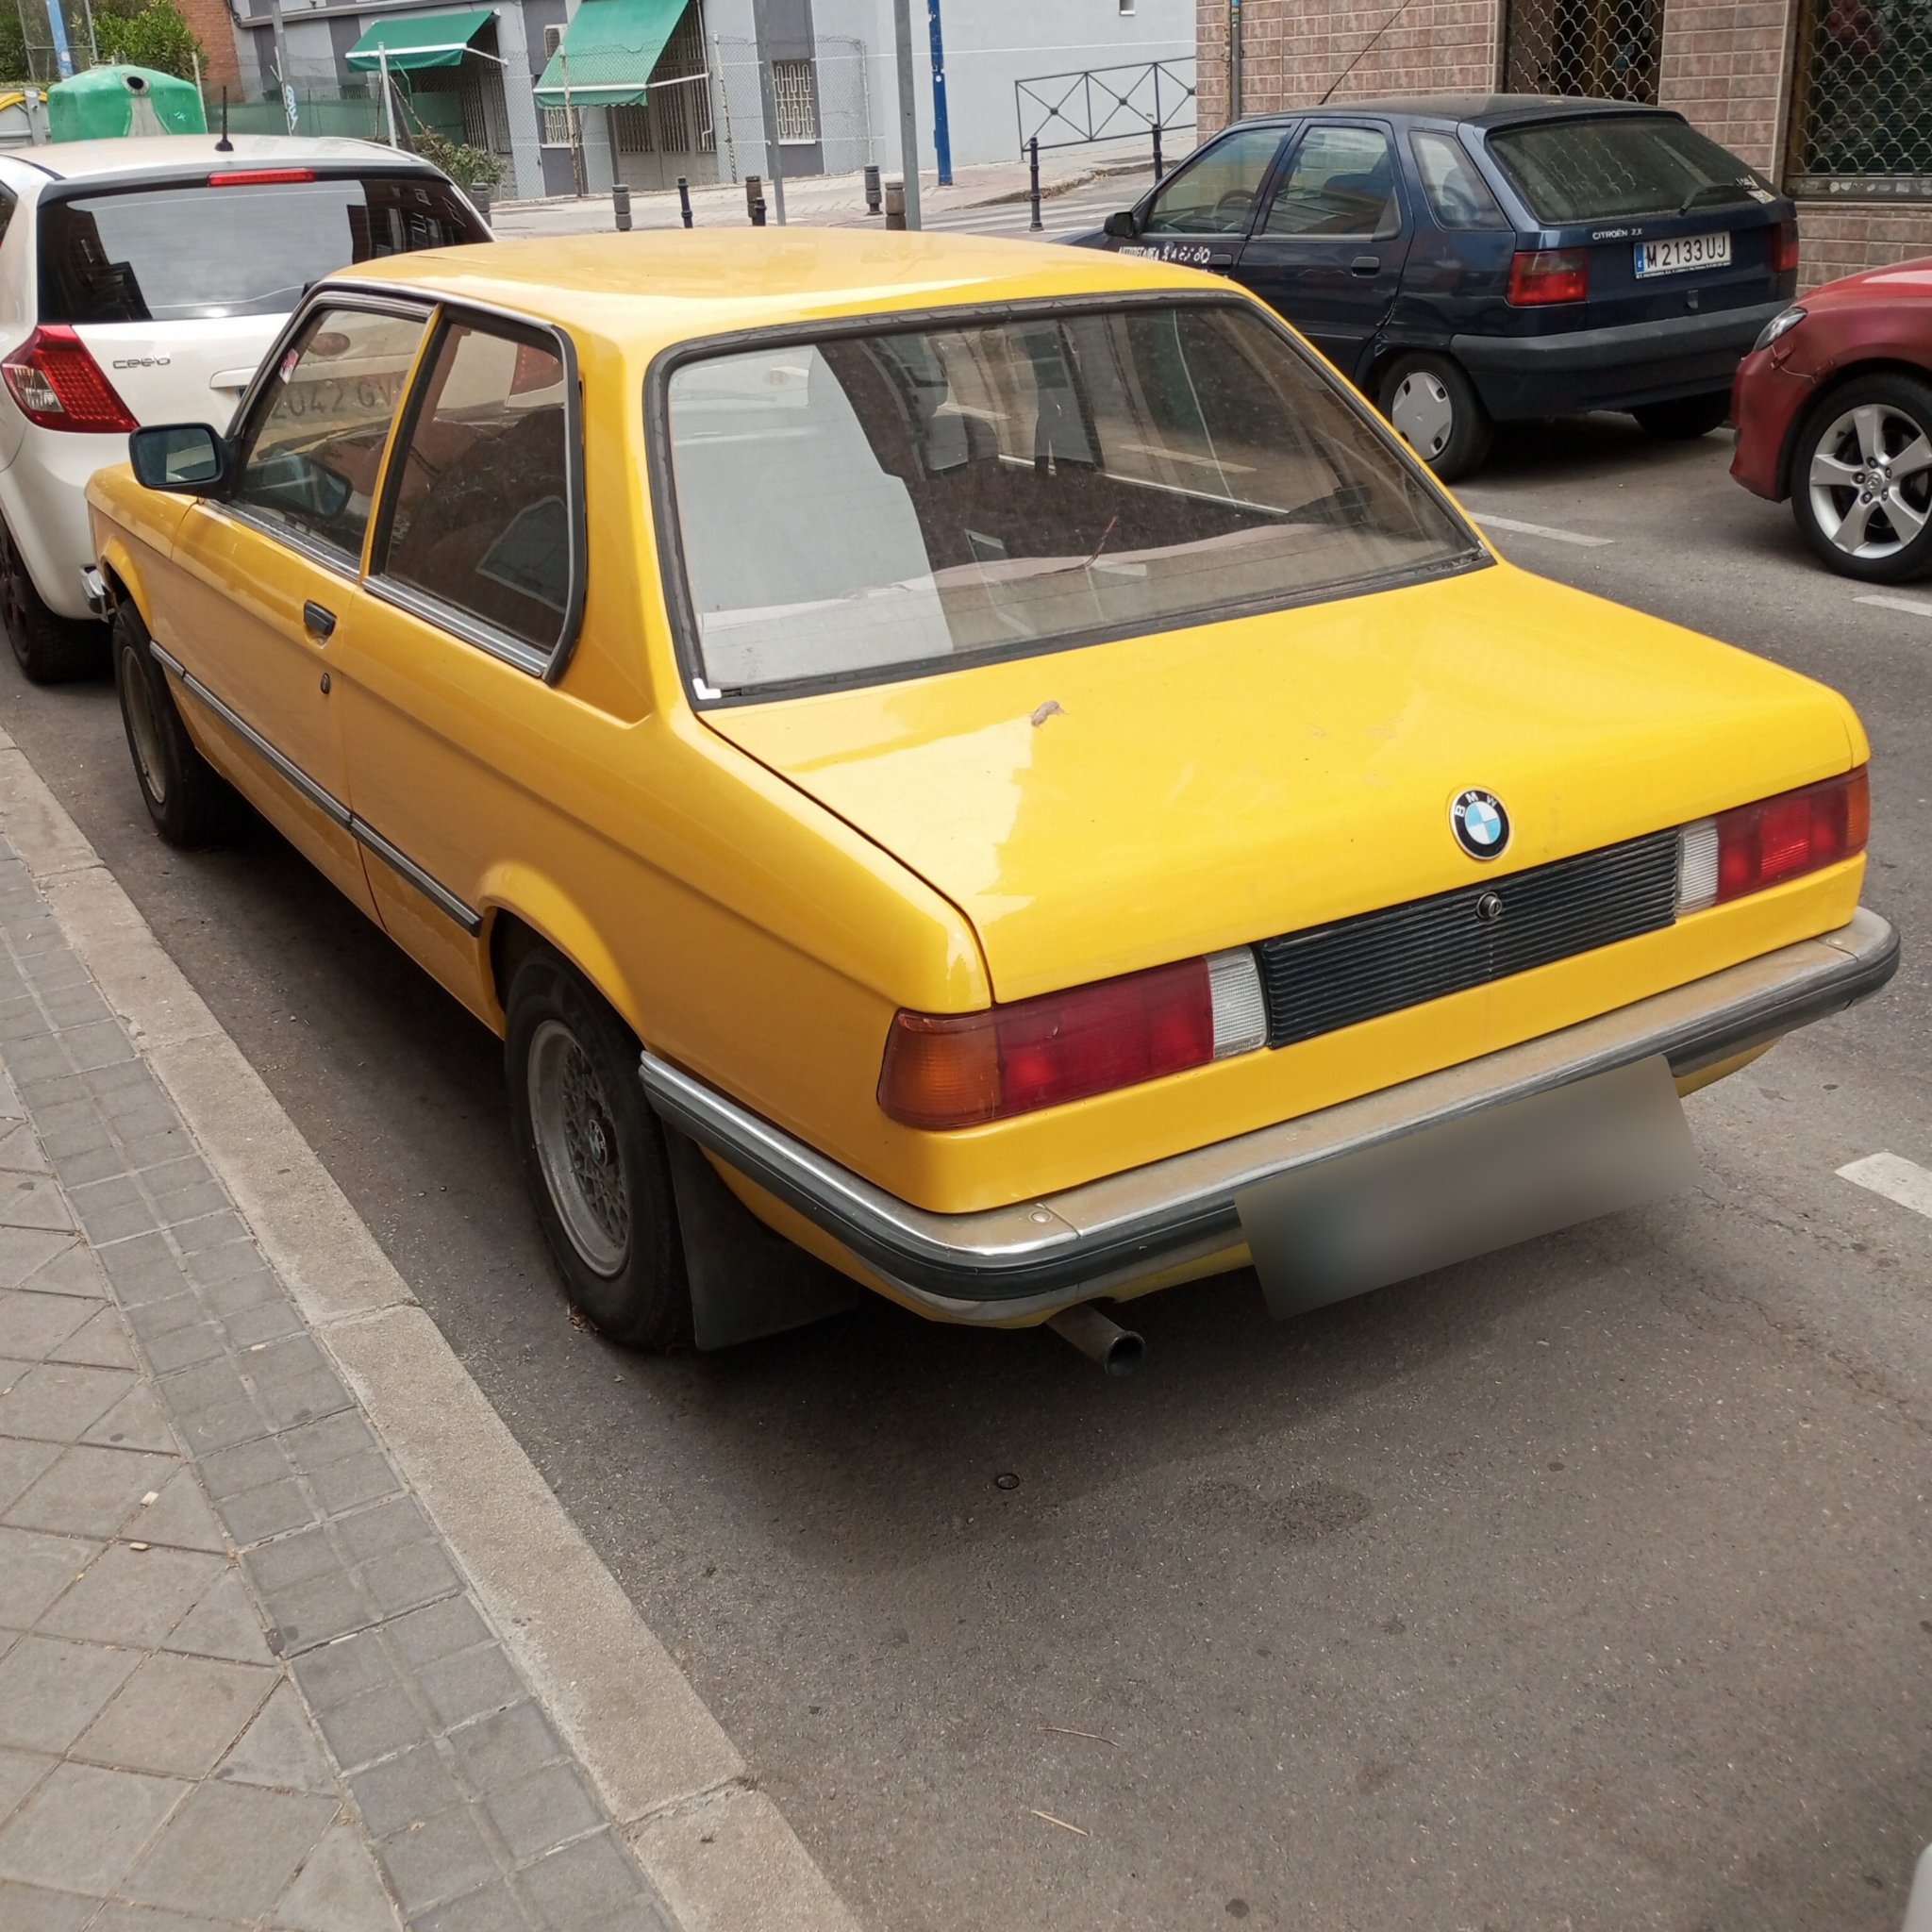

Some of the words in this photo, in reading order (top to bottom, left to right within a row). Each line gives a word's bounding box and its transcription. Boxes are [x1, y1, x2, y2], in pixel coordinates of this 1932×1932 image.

[1645, 244, 1657, 268] M
[1661, 239, 1704, 267] 2133
[1706, 235, 1726, 260] UJ
[1454, 791, 1498, 818] BMW
